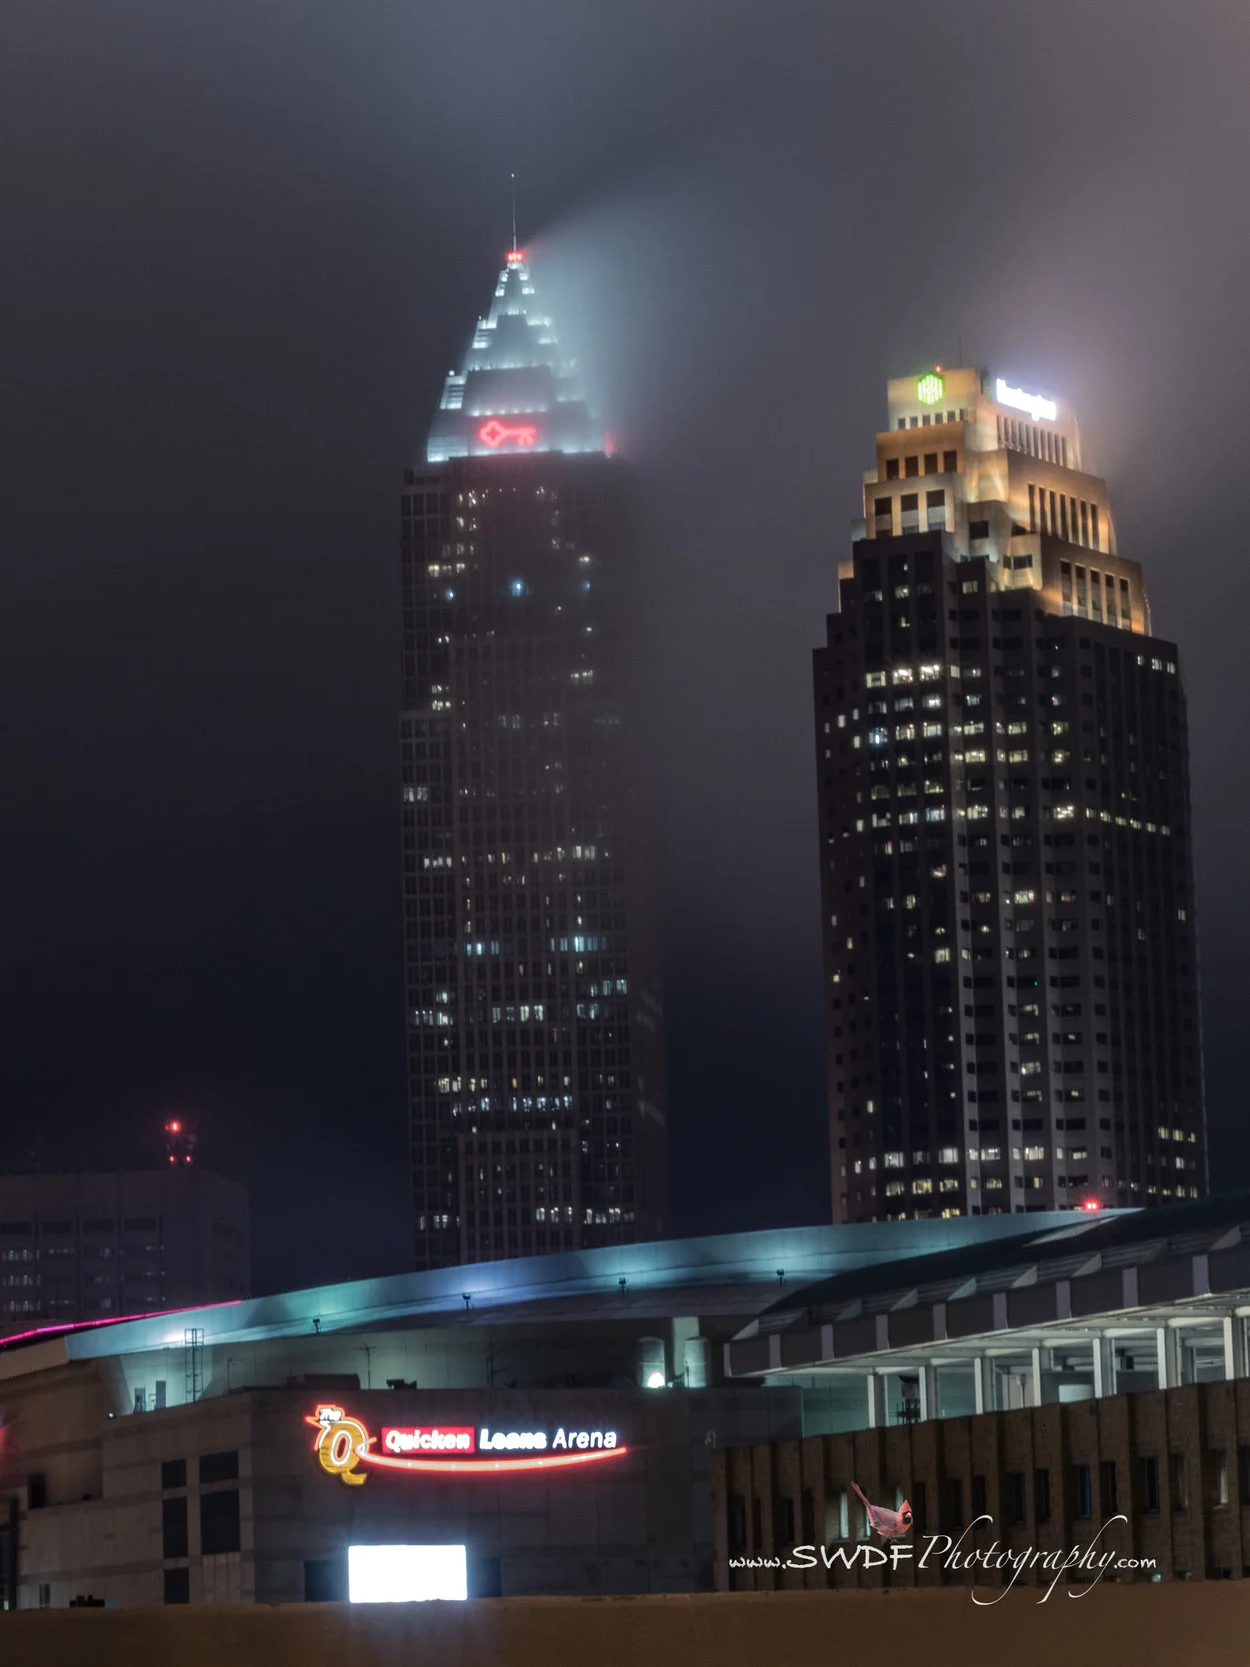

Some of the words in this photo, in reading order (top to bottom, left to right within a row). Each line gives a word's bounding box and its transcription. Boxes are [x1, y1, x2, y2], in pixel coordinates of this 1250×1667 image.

[385, 1429, 471, 1453] Quicken
[479, 1428, 547, 1450] Loans
[552, 1428, 617, 1449] Arena
